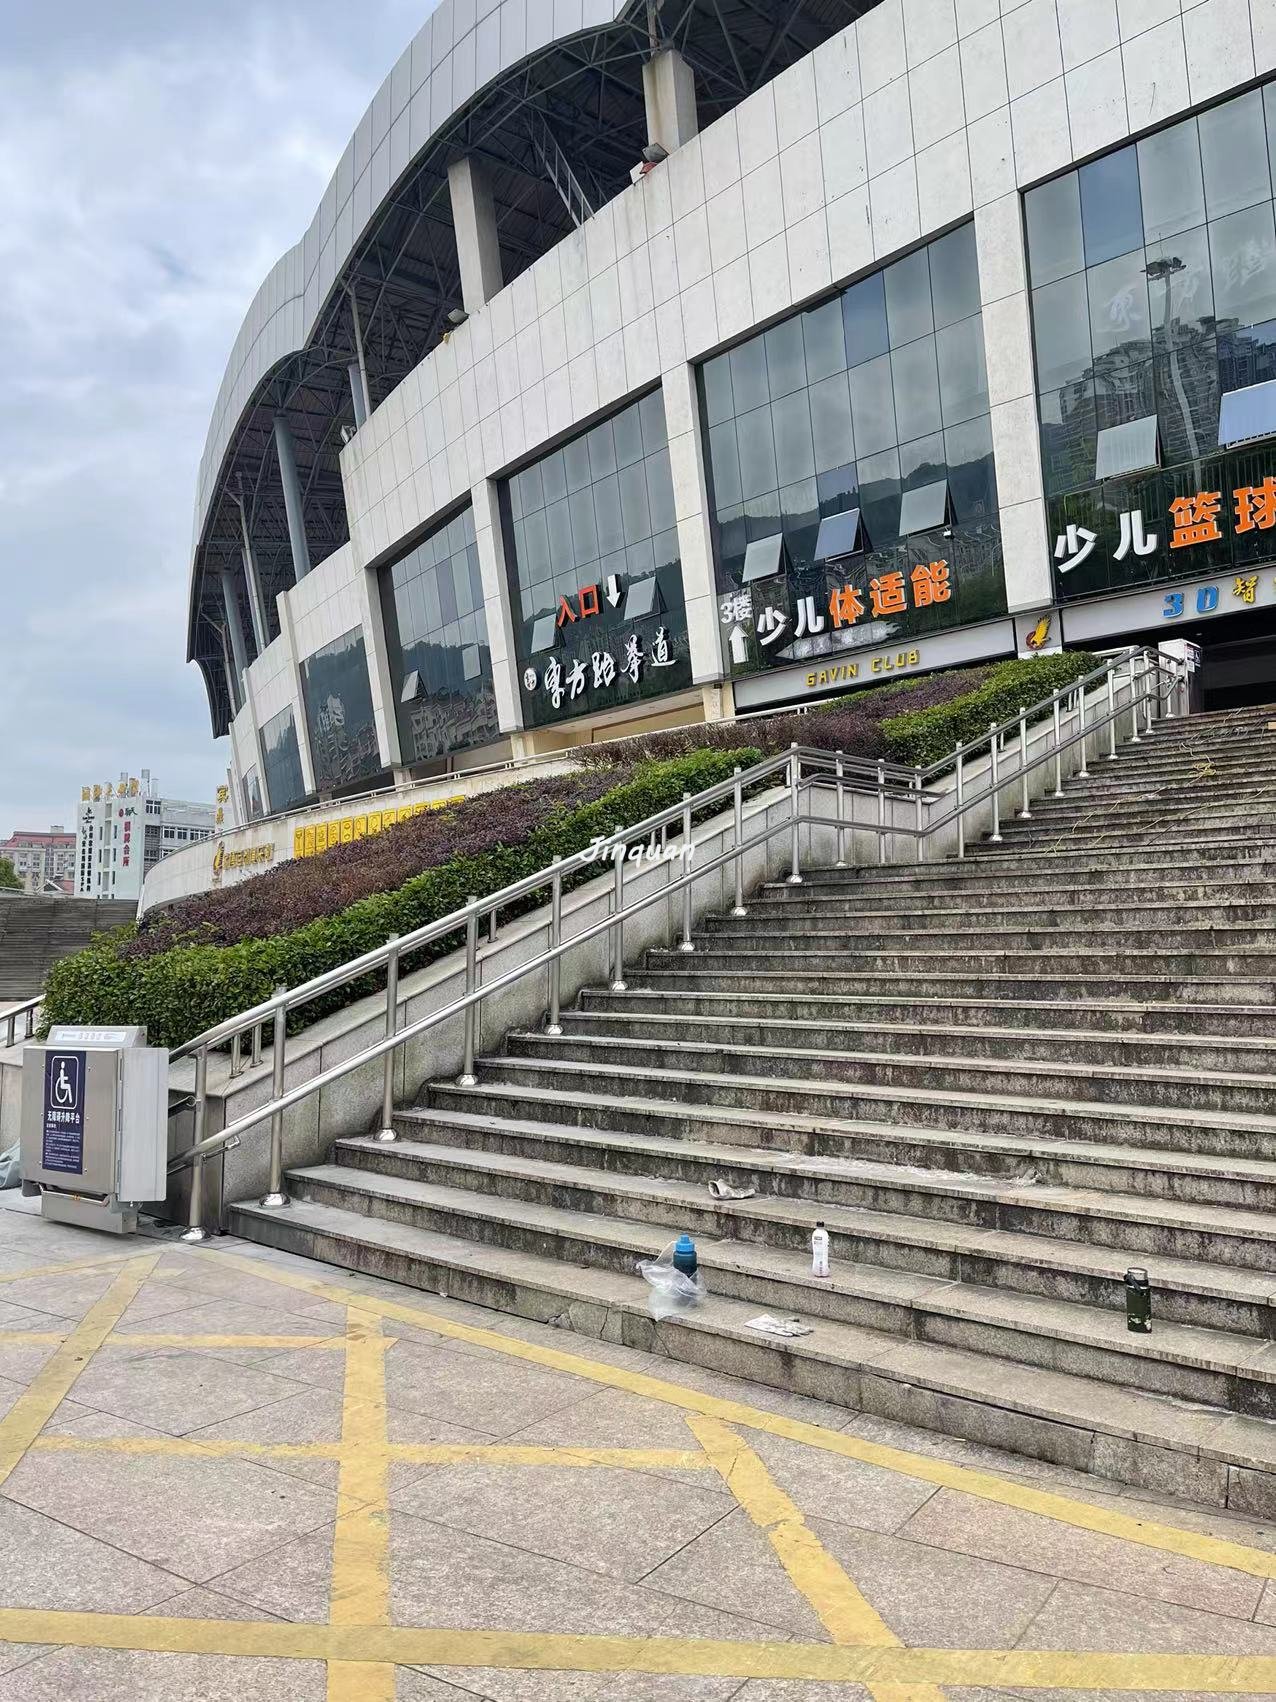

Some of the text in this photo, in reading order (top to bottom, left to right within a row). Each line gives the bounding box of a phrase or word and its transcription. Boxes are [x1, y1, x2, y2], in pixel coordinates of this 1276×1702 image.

[1054, 477, 1276, 573] 少儿篮球
[557, 584, 600, 627] 入口
[721, 591, 753, 624] 3楼
[757, 559, 951, 646] 少儿体适能
[1162, 575, 1276, 619] 3D智
[805, 650, 920, 687] GAVIN CLUB
[47, 1110, 80, 1124] 无障碍升降平台
